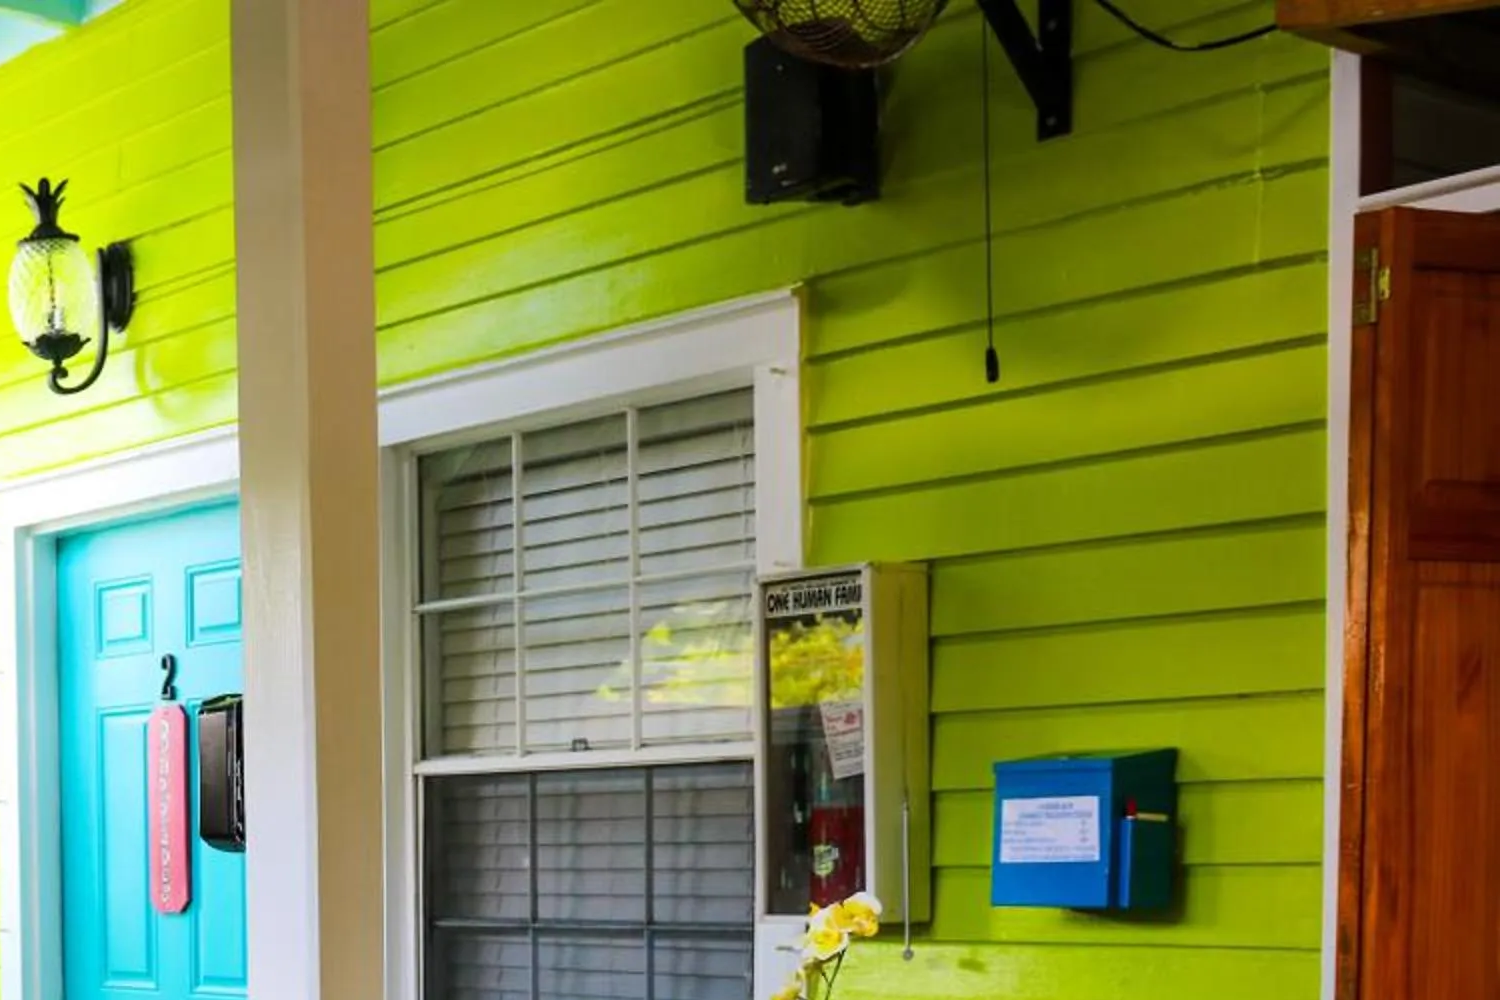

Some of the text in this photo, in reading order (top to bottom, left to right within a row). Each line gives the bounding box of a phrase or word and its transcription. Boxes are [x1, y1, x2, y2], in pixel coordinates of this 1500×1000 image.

[766, 593, 788, 613] ONE
[792, 587, 833, 609] HUMAN
[160, 653, 177, 701] 2
